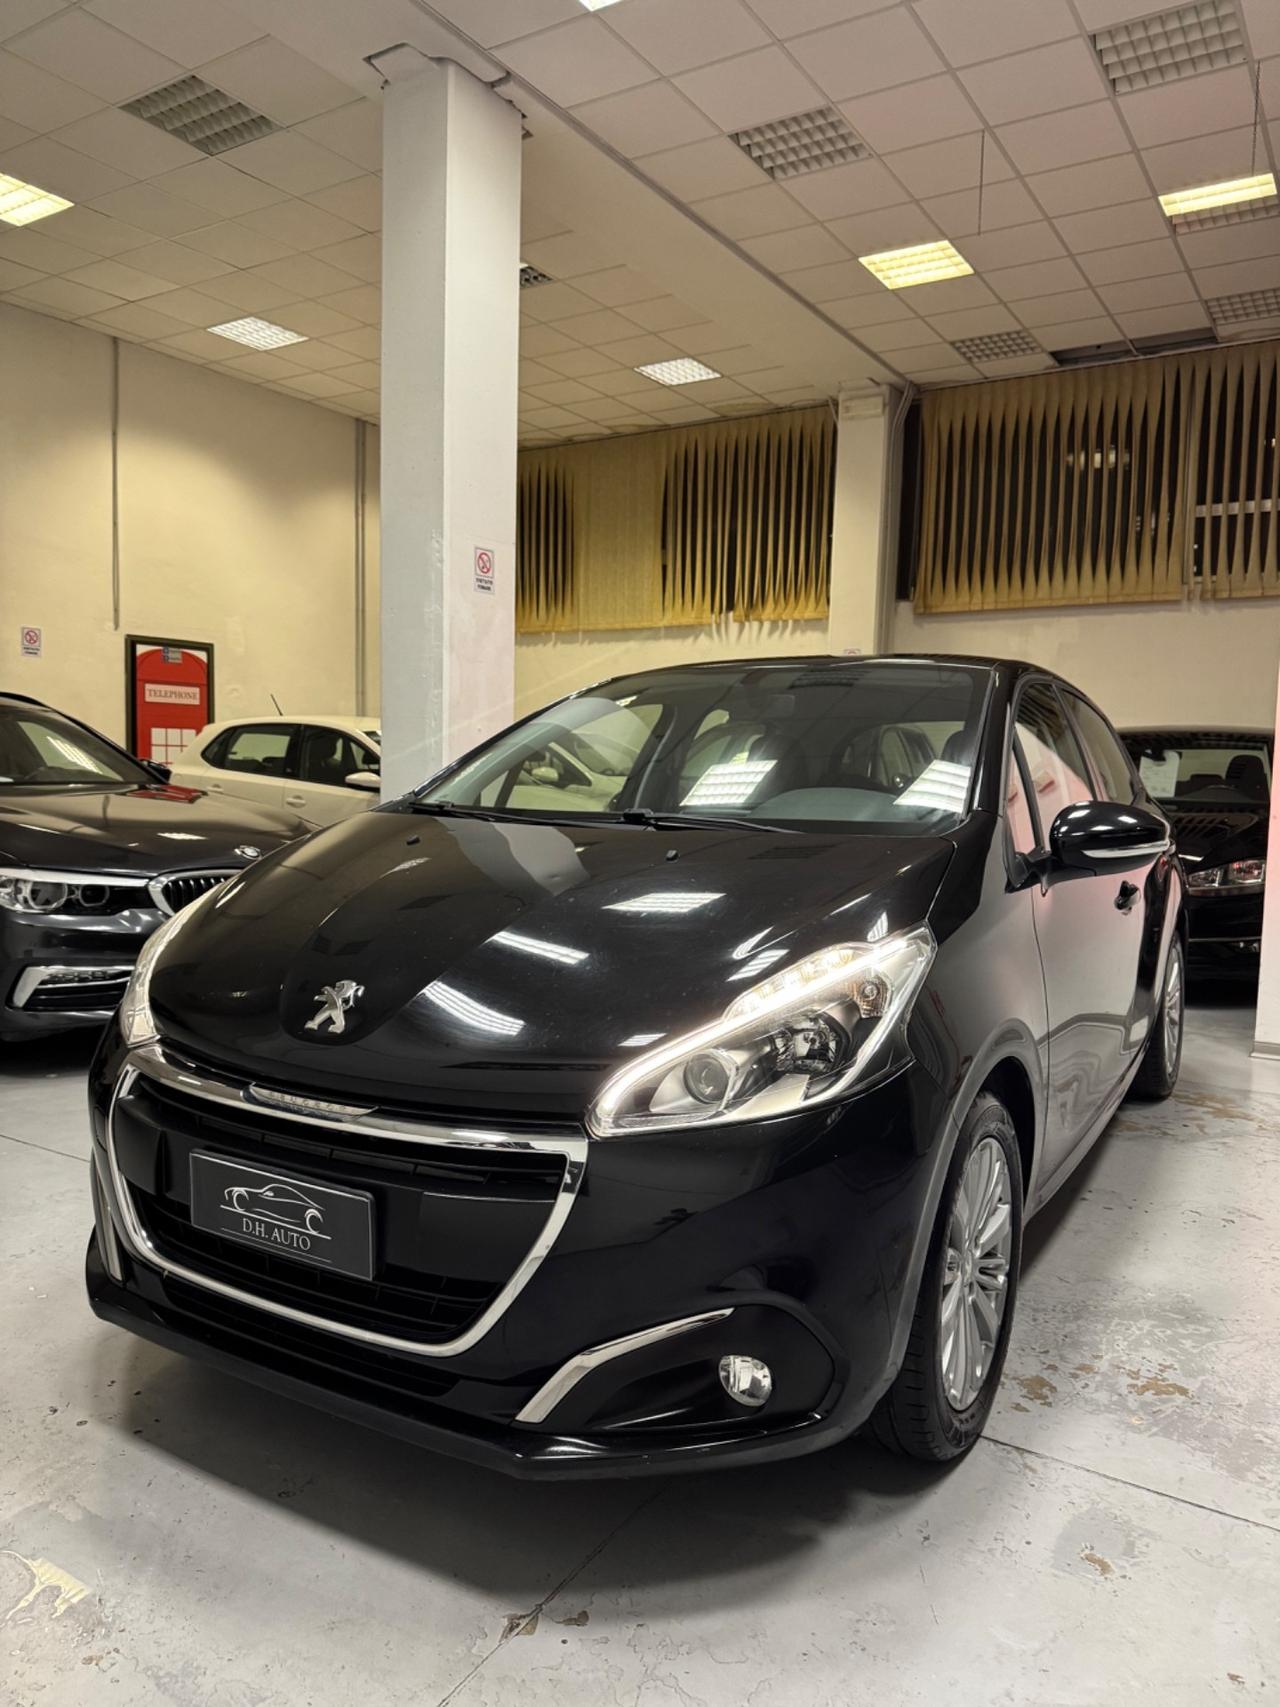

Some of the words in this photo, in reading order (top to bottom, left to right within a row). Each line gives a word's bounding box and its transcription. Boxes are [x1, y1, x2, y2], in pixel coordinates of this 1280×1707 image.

[147, 689, 198, 700] TELEPHONE
[243, 1218, 268, 1238] D.H.
[271, 1230, 311, 1250] AUTO
